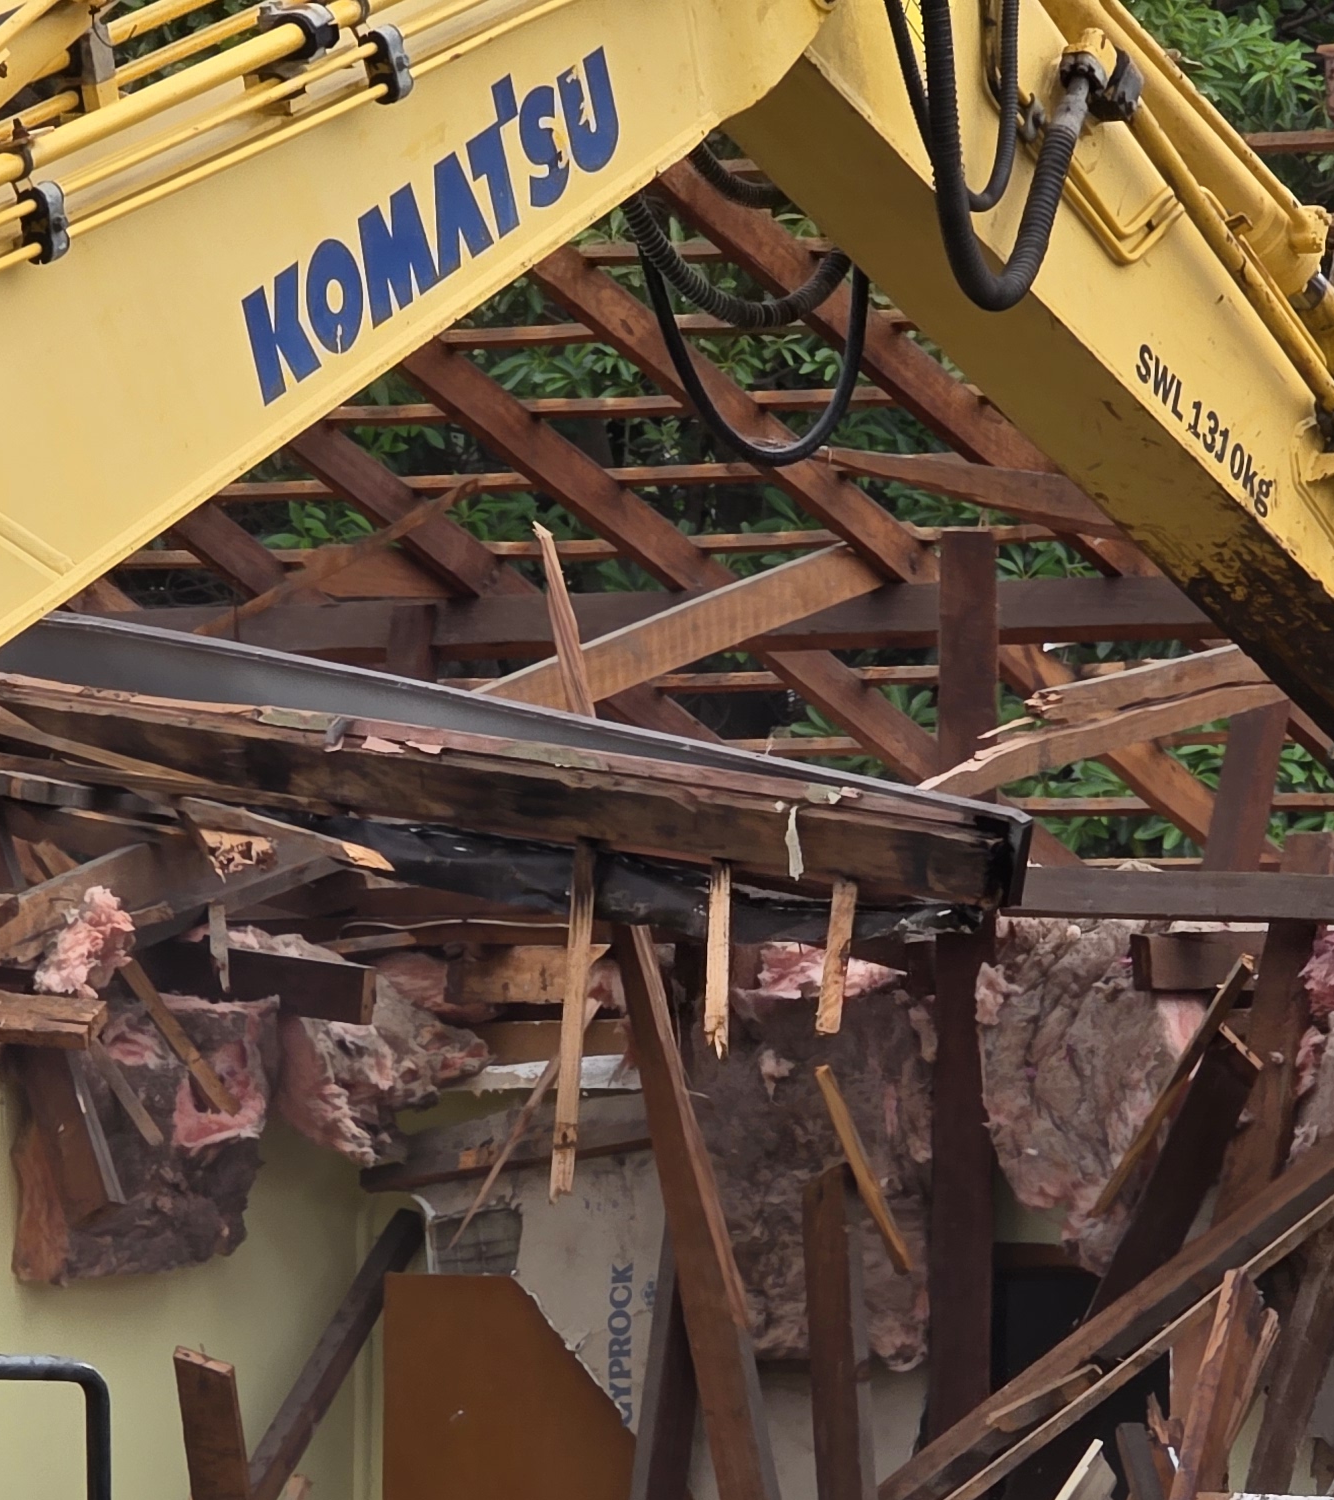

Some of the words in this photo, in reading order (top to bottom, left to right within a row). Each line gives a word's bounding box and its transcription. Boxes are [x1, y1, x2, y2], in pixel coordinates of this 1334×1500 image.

[241, 45, 620, 407] KOMATSU
[1135, 343, 1184, 423] SWL
[1186, 400, 1274, 518] 1310kg
